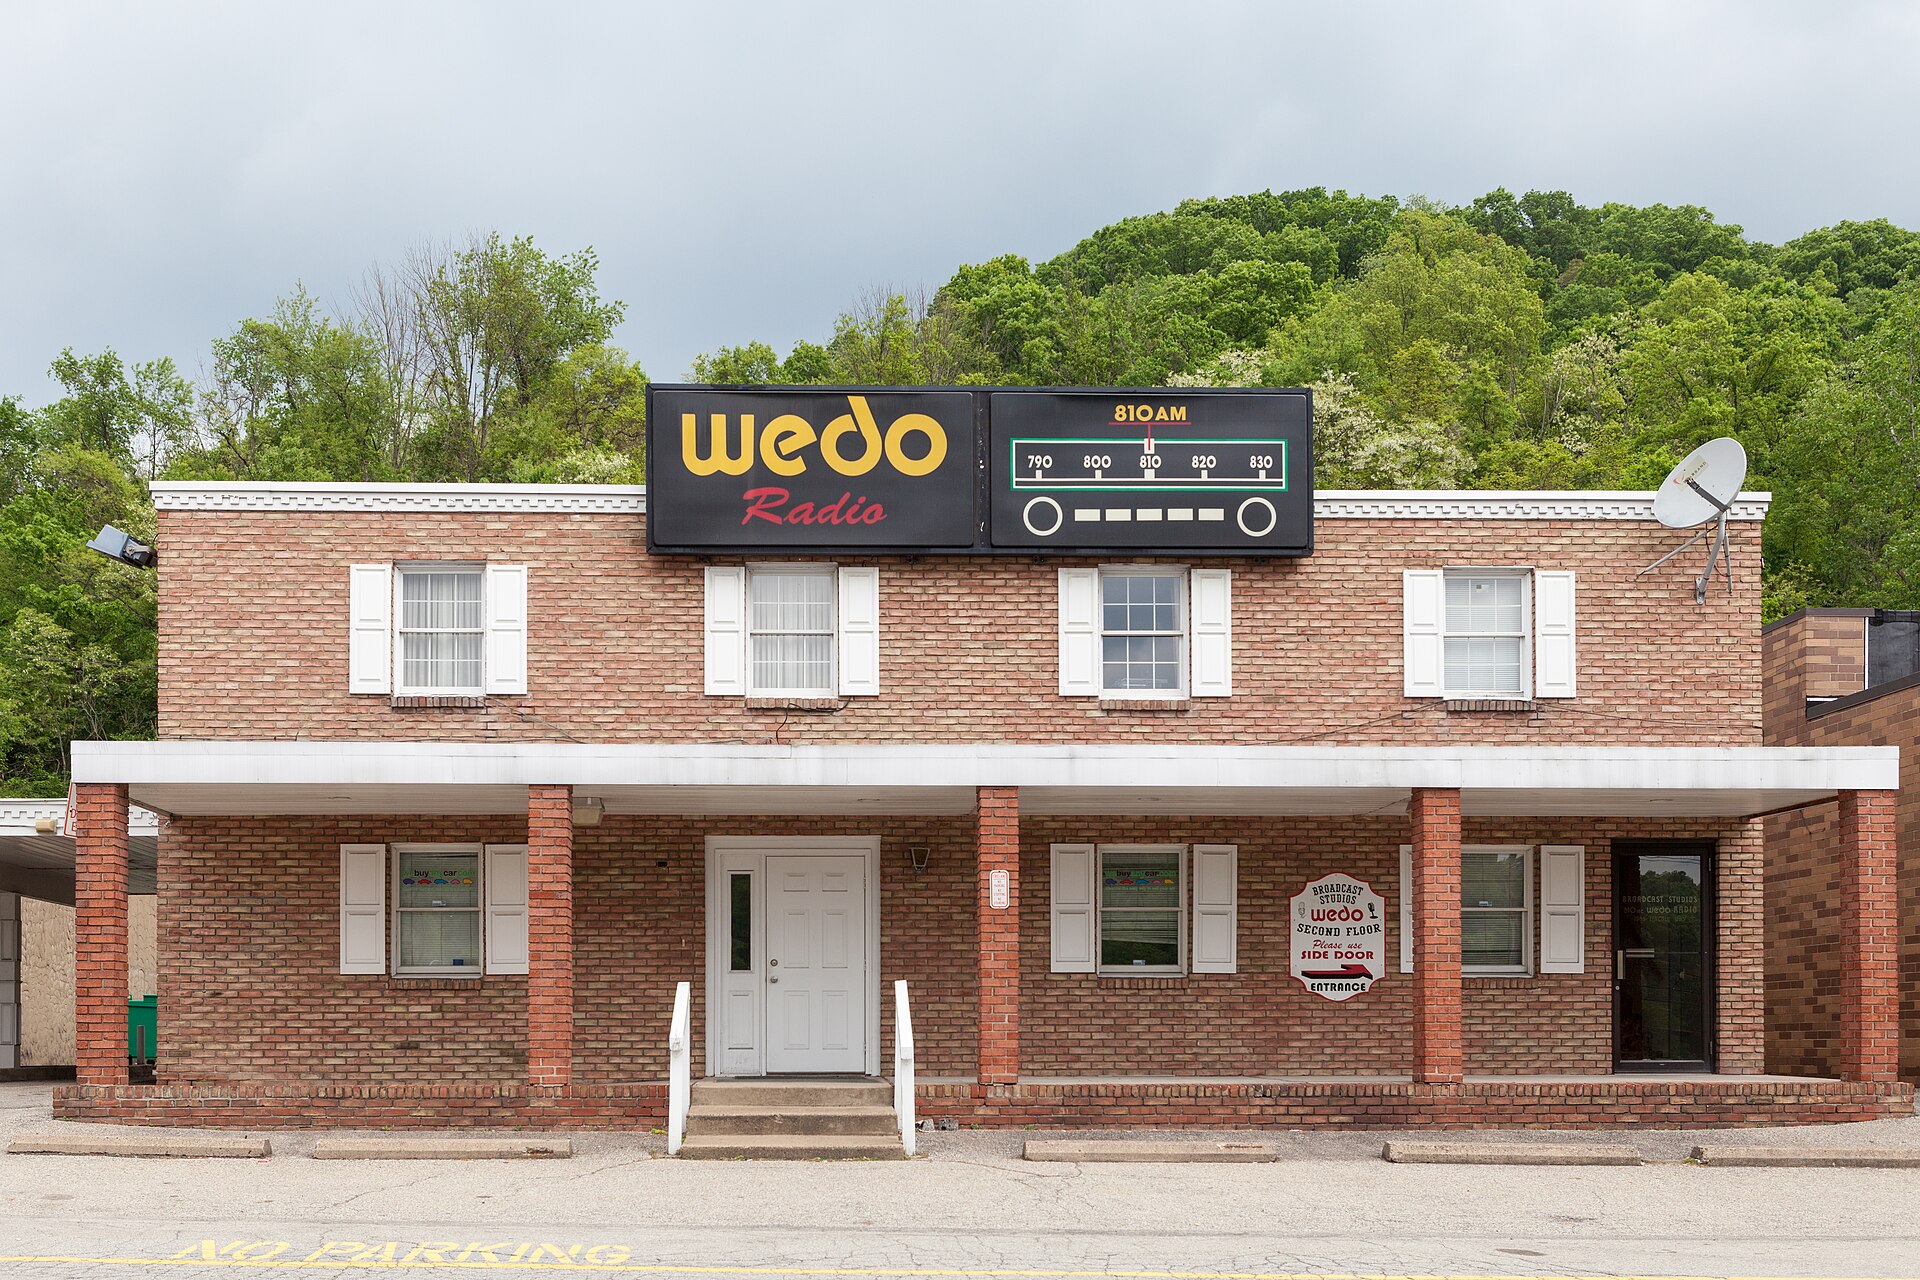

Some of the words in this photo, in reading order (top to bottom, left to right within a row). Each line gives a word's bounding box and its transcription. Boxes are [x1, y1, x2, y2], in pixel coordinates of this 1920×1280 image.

[682, 395, 948, 477] wedo
[1027, 455, 1053, 469] 790
[1083, 455, 1112, 469] 800
[1139, 455, 1162, 469] 810
[1191, 455, 1217, 469] 820
[1249, 455, 1273, 469] 830
[741, 486, 888, 526] Radio
[1312, 884, 1364, 896] BROADCAST
[1319, 894, 1357, 905] STUDIOS
[1622, 895, 1664, 903] BROADCAST
[1668, 895, 1698, 903] STUDIOS
[1311, 904, 1364, 922] wedo
[1646, 905, 1671, 914] wedo
[1673, 905, 1698, 914] RADIO
[1296, 923, 1341, 937] SECOND
[1346, 923, 1382, 937] FLOOR
[1312, 939, 1343, 950] Please
[1347, 942, 1363, 950] use
[1301, 950, 1329, 960] SIDE
[1334, 950, 1374, 960] DOOR
[1310, 982, 1366, 992] ENTRANCE
[170, 1239, 290, 1260] NO
[303, 1240, 633, 1265] PARKING
